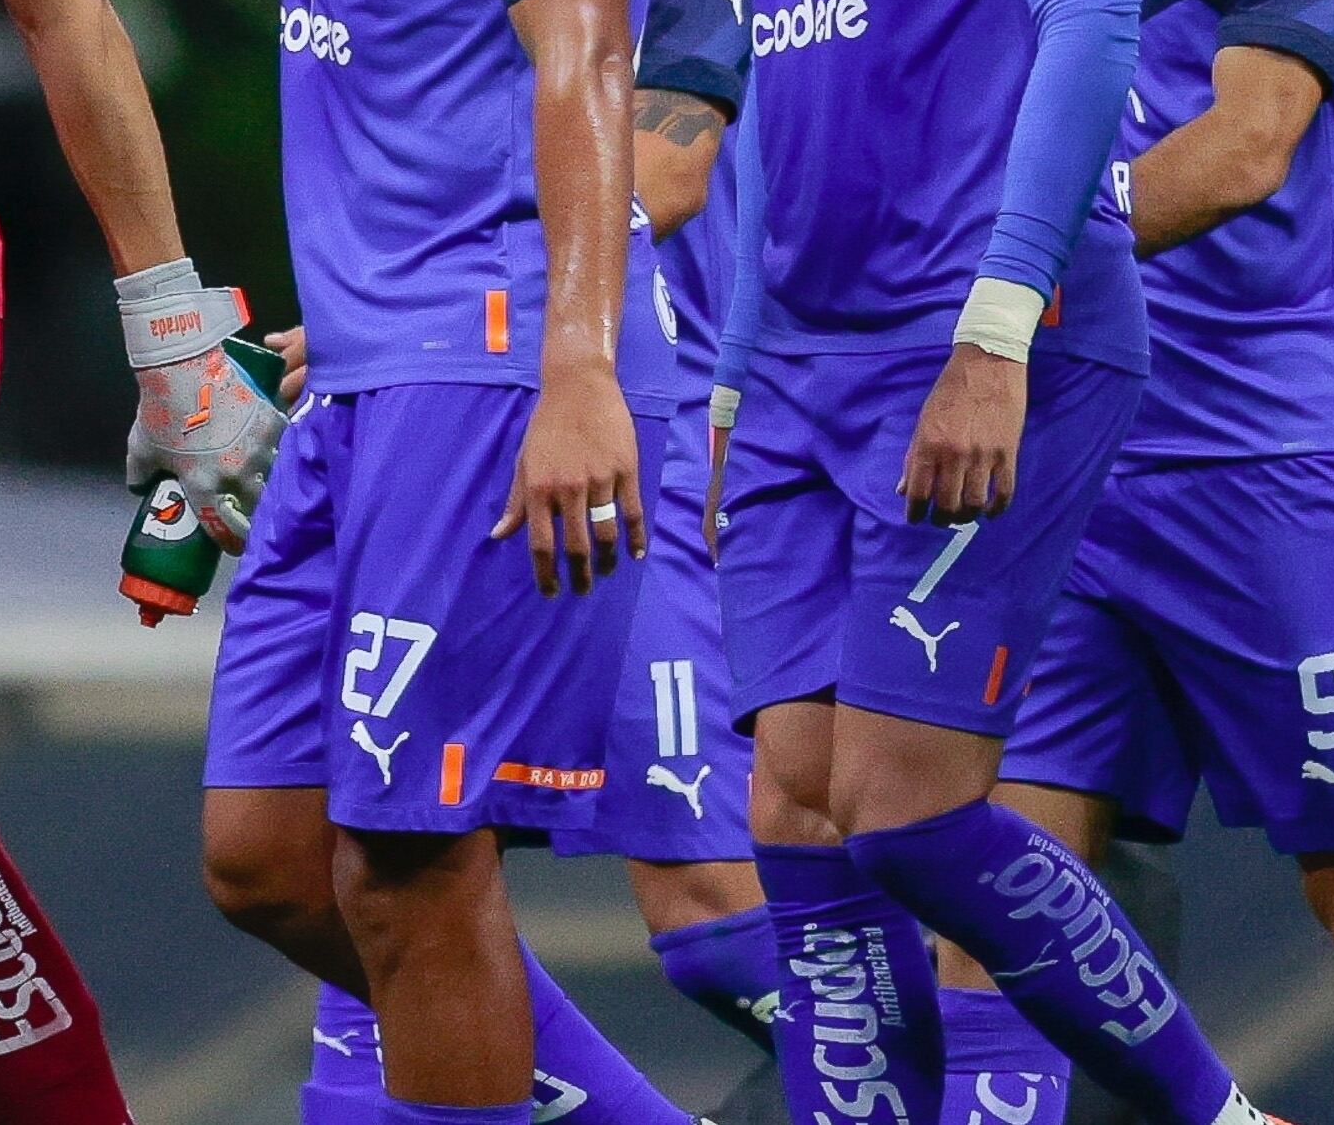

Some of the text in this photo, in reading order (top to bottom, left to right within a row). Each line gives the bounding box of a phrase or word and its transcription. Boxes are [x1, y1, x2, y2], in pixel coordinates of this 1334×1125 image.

[342, 611, 438, 718] 27
[650, 659, 699, 757] 11
[789, 929, 911, 1125] scudo
